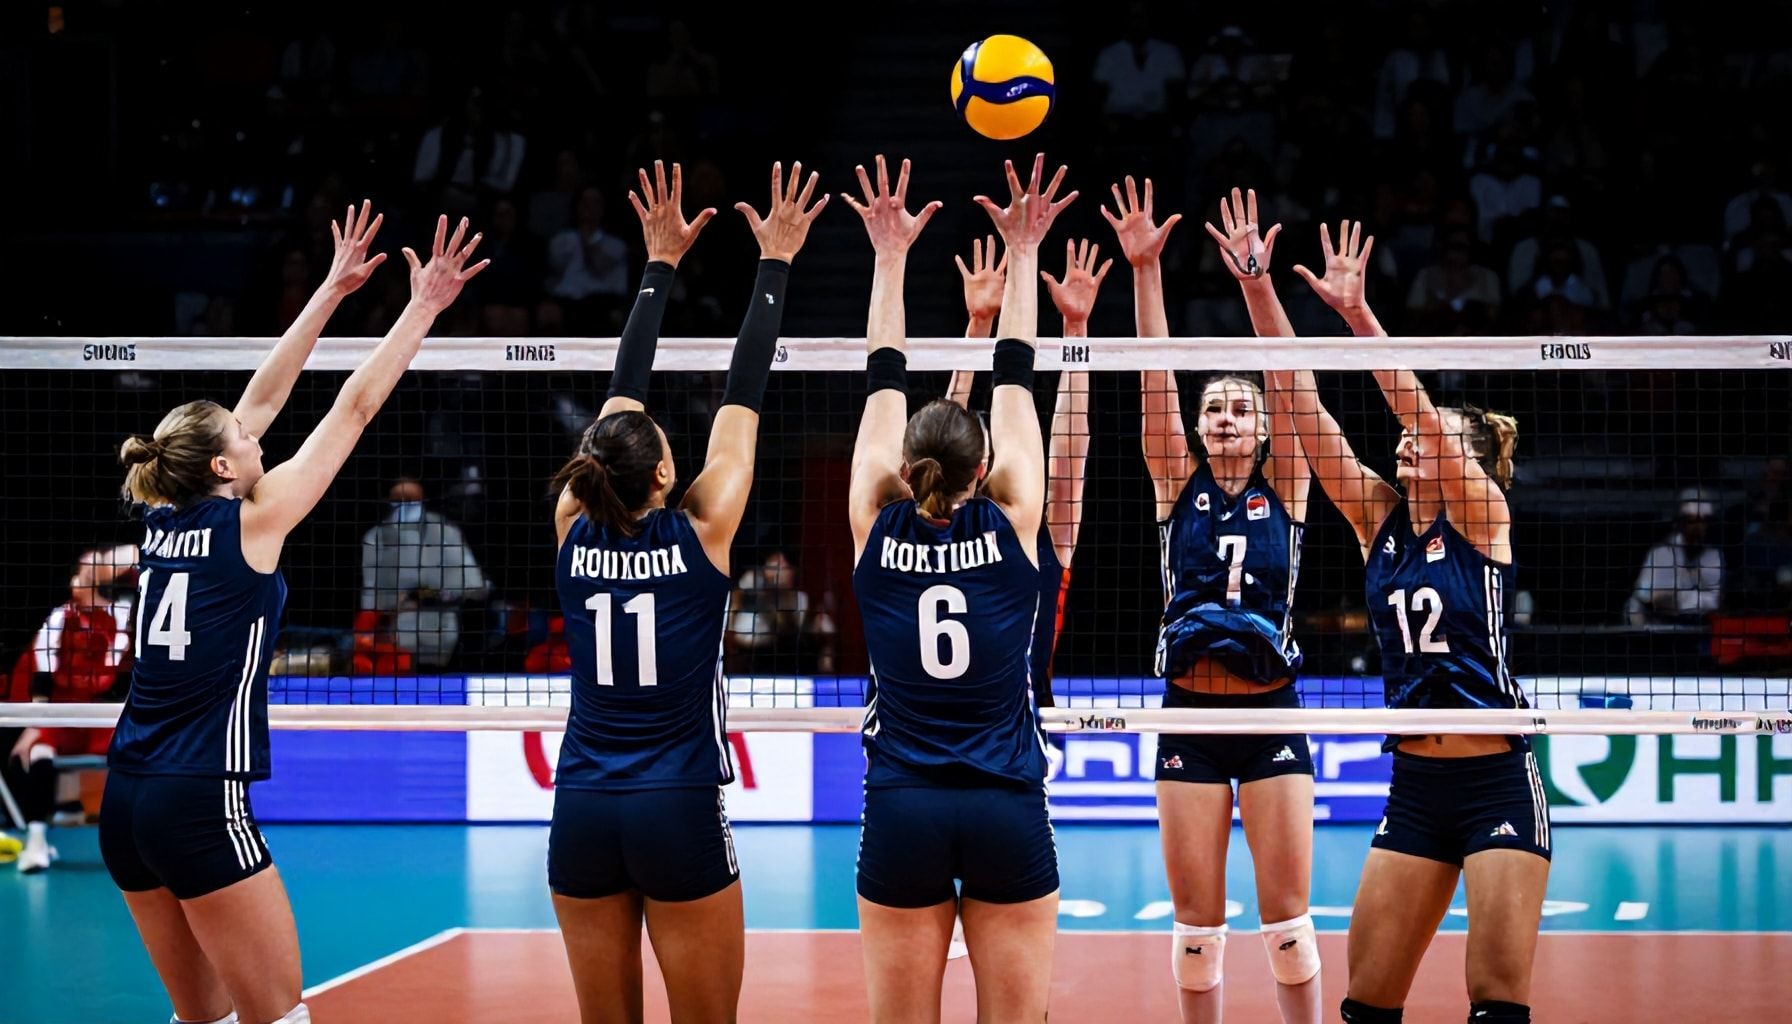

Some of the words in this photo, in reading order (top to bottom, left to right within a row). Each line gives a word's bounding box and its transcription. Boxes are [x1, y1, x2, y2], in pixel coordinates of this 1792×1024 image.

[135, 567, 192, 661] 14
[1216, 535, 1248, 606] 7
[585, 592, 658, 687] 11
[918, 584, 971, 680] 6
[1387, 586, 1451, 654] 12
